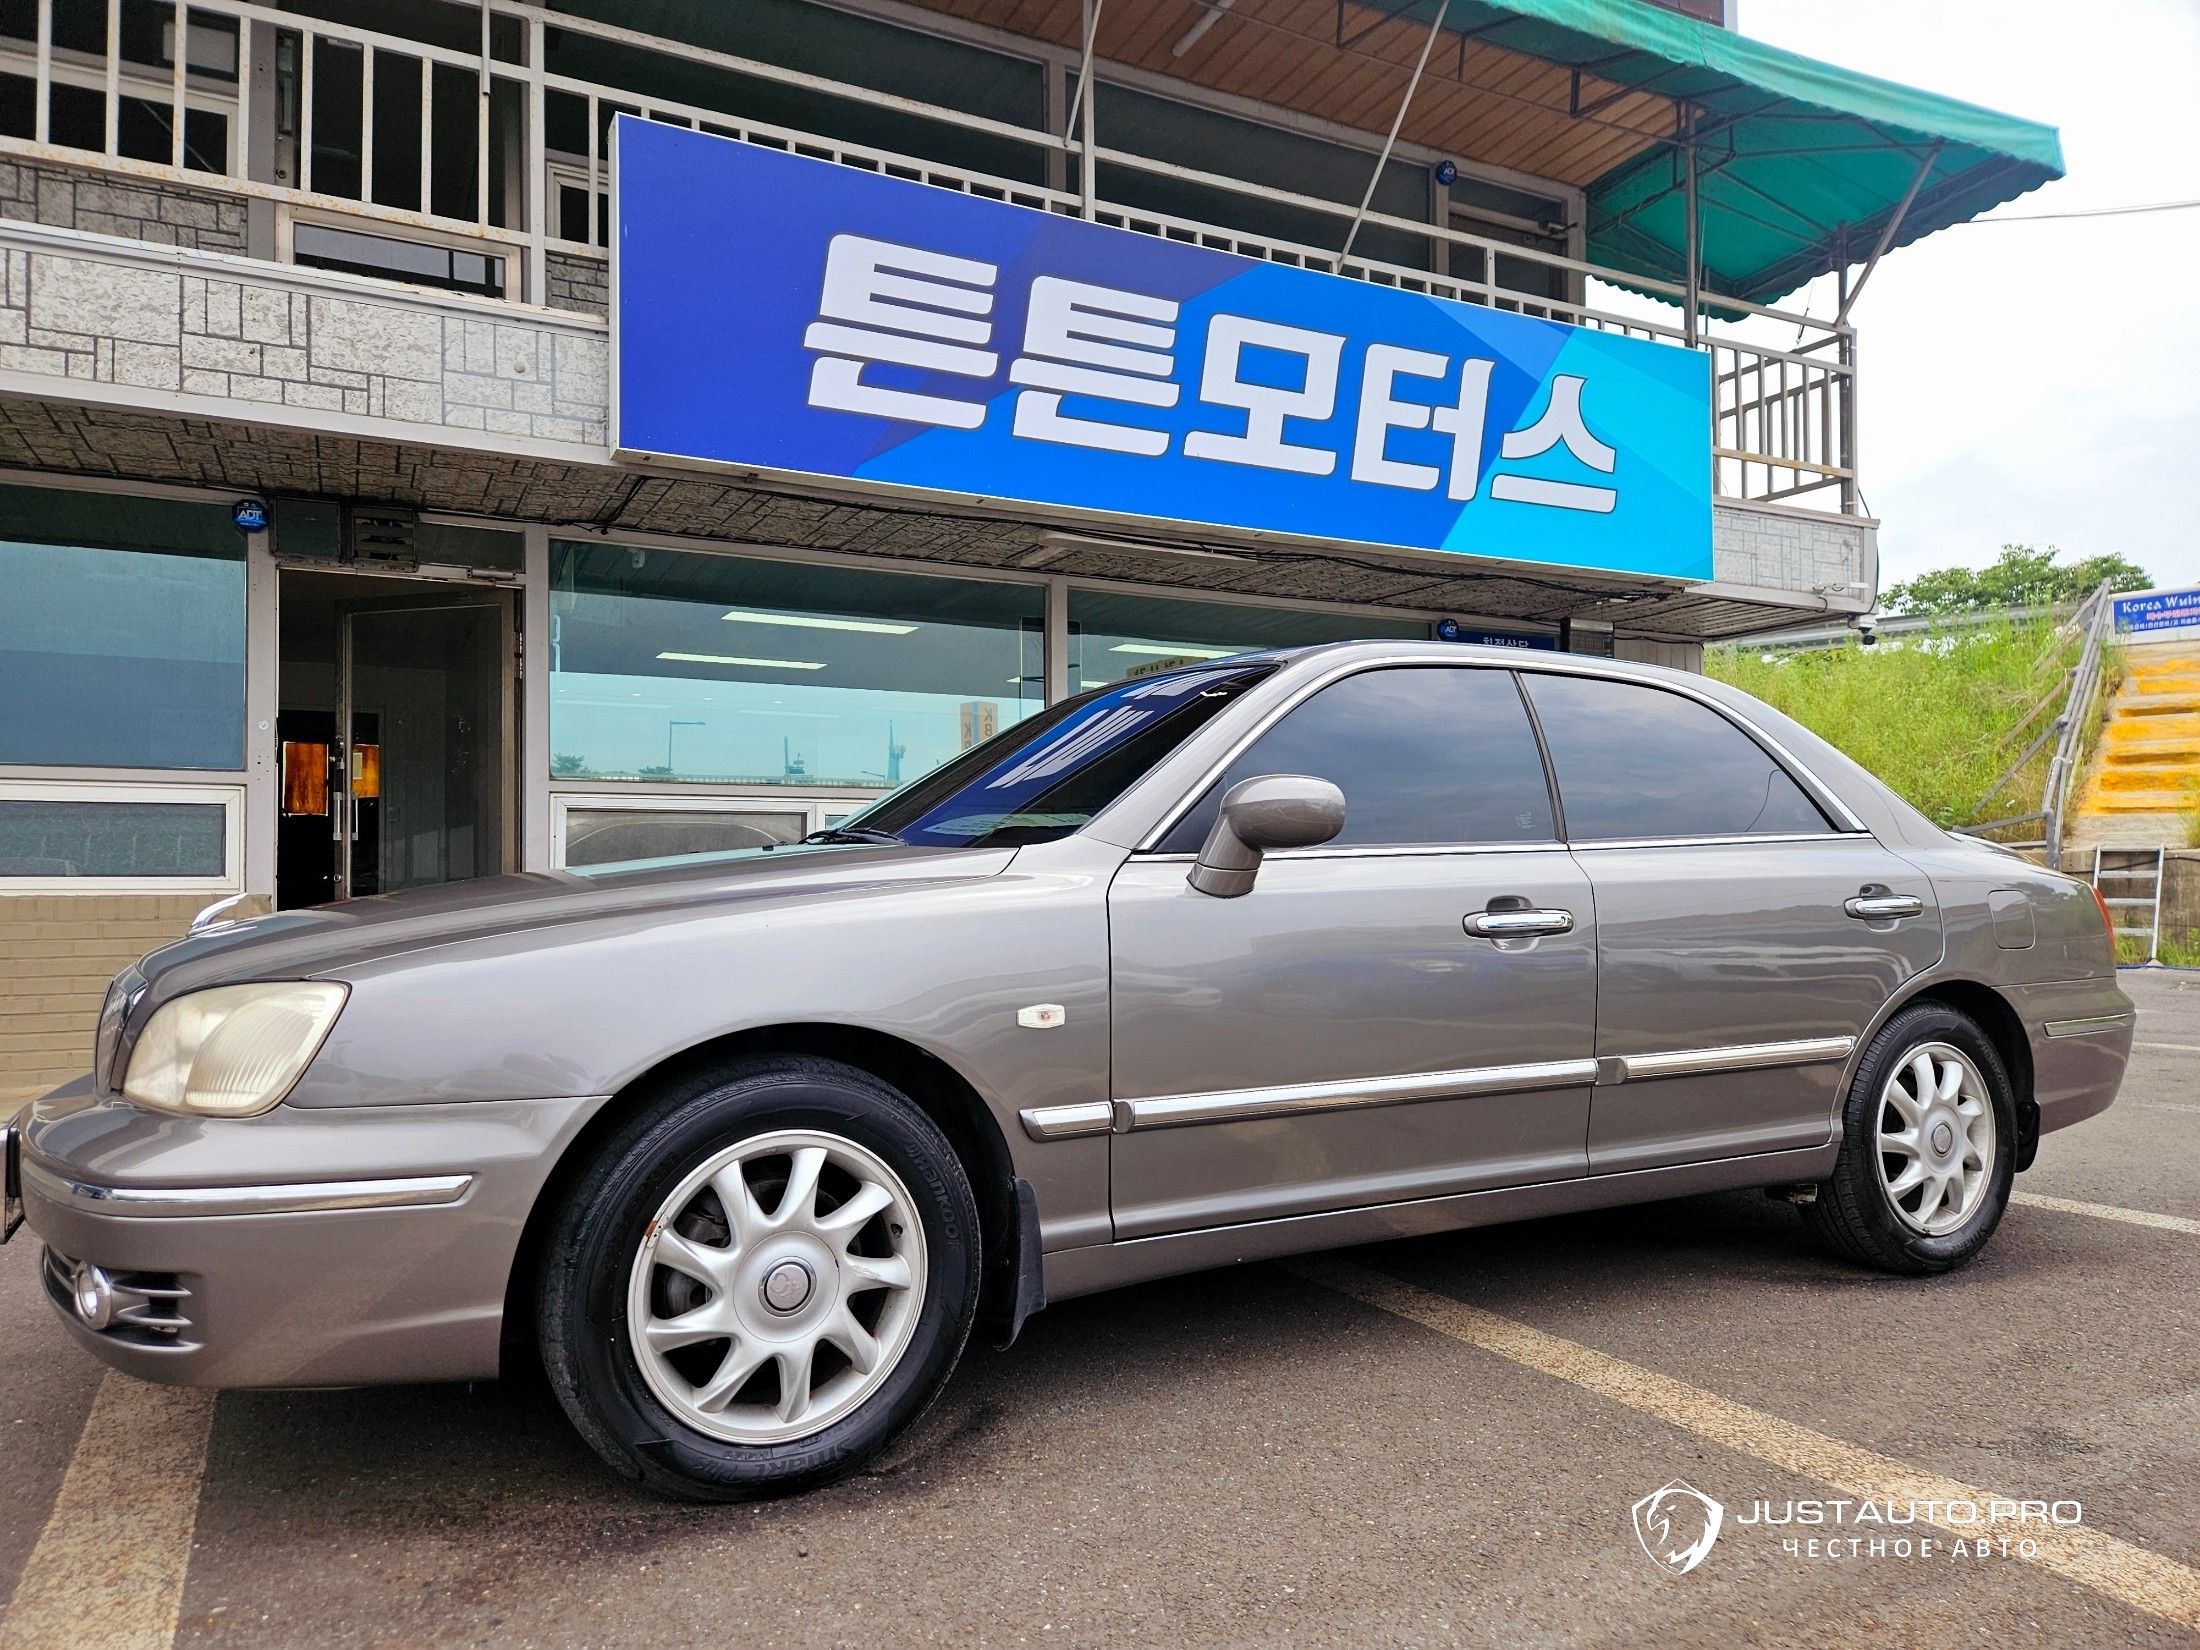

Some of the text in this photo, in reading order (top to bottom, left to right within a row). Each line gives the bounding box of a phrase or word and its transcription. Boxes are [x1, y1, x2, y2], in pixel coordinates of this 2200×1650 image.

[804, 235, 1616, 514] 튼튼모터스
[237, 509, 262, 520] ADT
[2122, 600, 2162, 613] Korea
[1445, 625, 1457, 634] ADT
